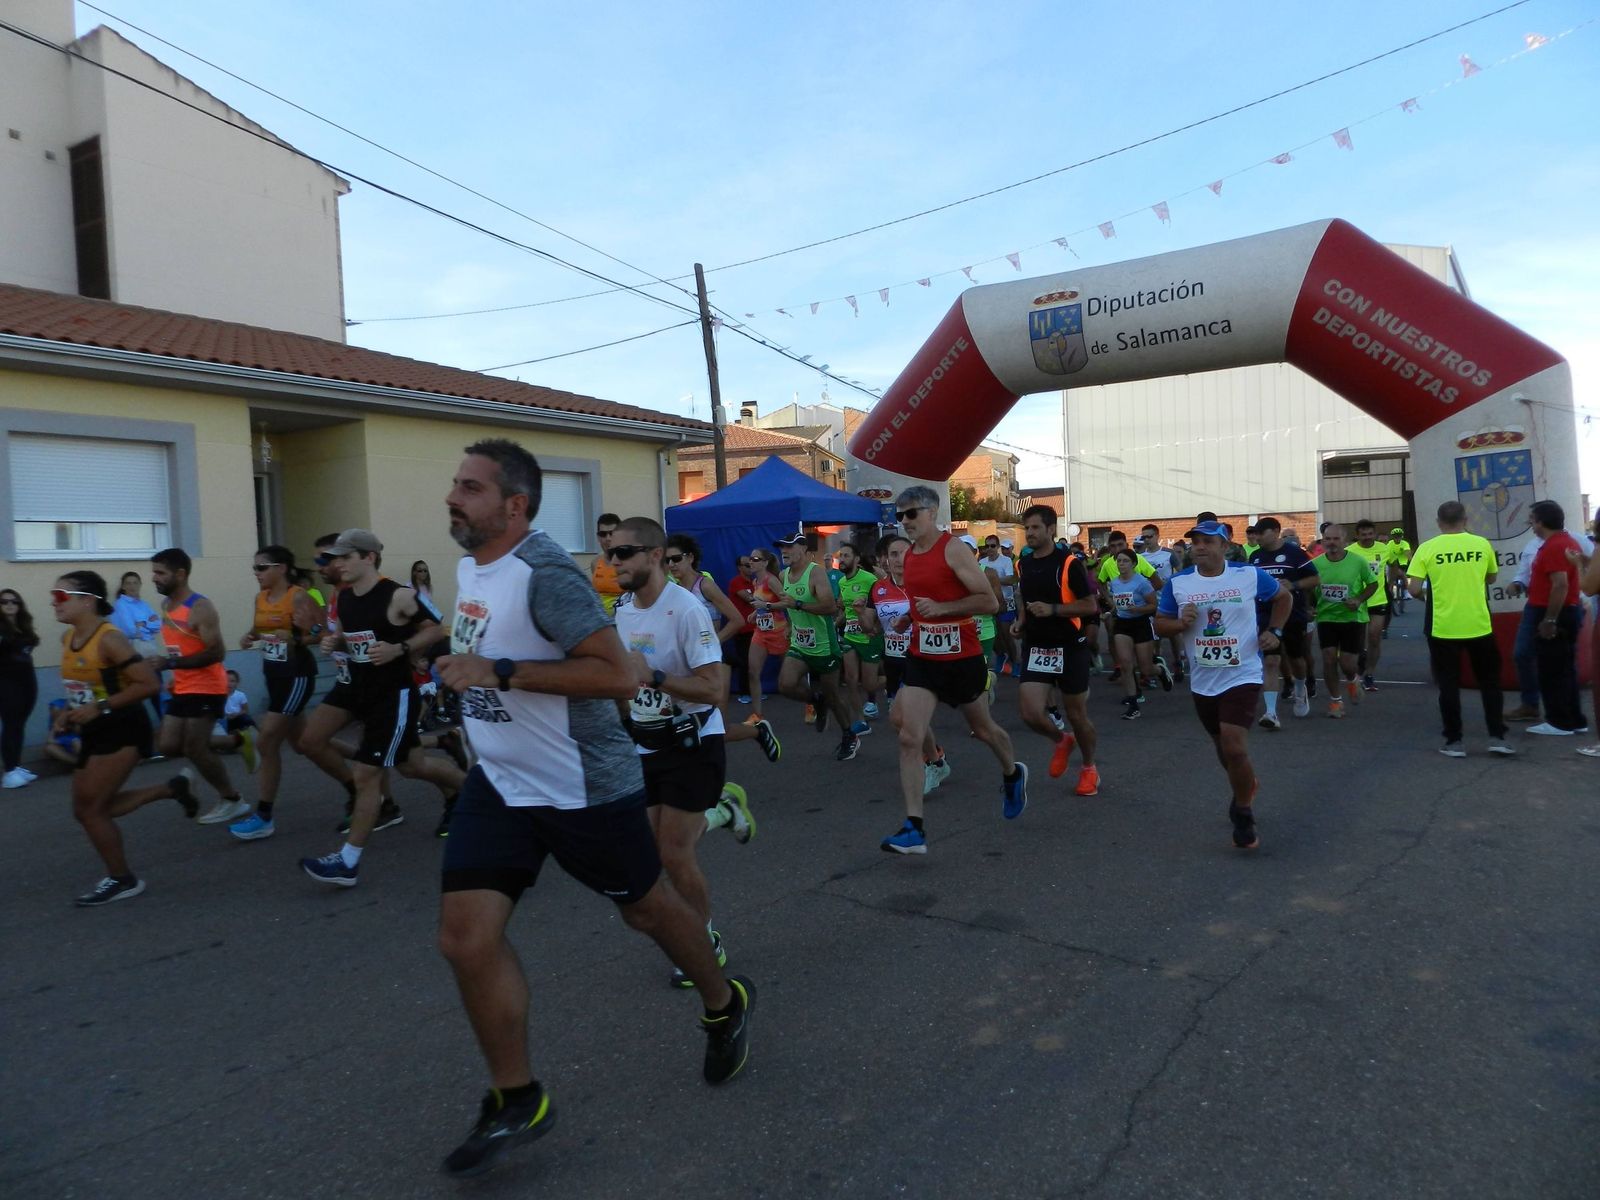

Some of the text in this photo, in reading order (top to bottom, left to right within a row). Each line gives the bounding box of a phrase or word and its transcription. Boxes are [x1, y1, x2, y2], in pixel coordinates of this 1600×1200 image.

[1087, 280, 1204, 317] Diputación
[1091, 319, 1233, 355] de Salamanca
[1323, 279, 1492, 387] CON NUESTROS
[1312, 307, 1460, 404] DEPORTISTAS
[865, 336, 969, 460] CON EL DEPORTE
[1435, 551, 1483, 565] STAFF
[1325, 590, 1344, 599] 443
[886, 640, 905, 652] 495
[925, 634, 951, 648] 401
[1202, 646, 1233, 660] 493
[1034, 656, 1058, 668] 482
[634, 688, 663, 709] 439
